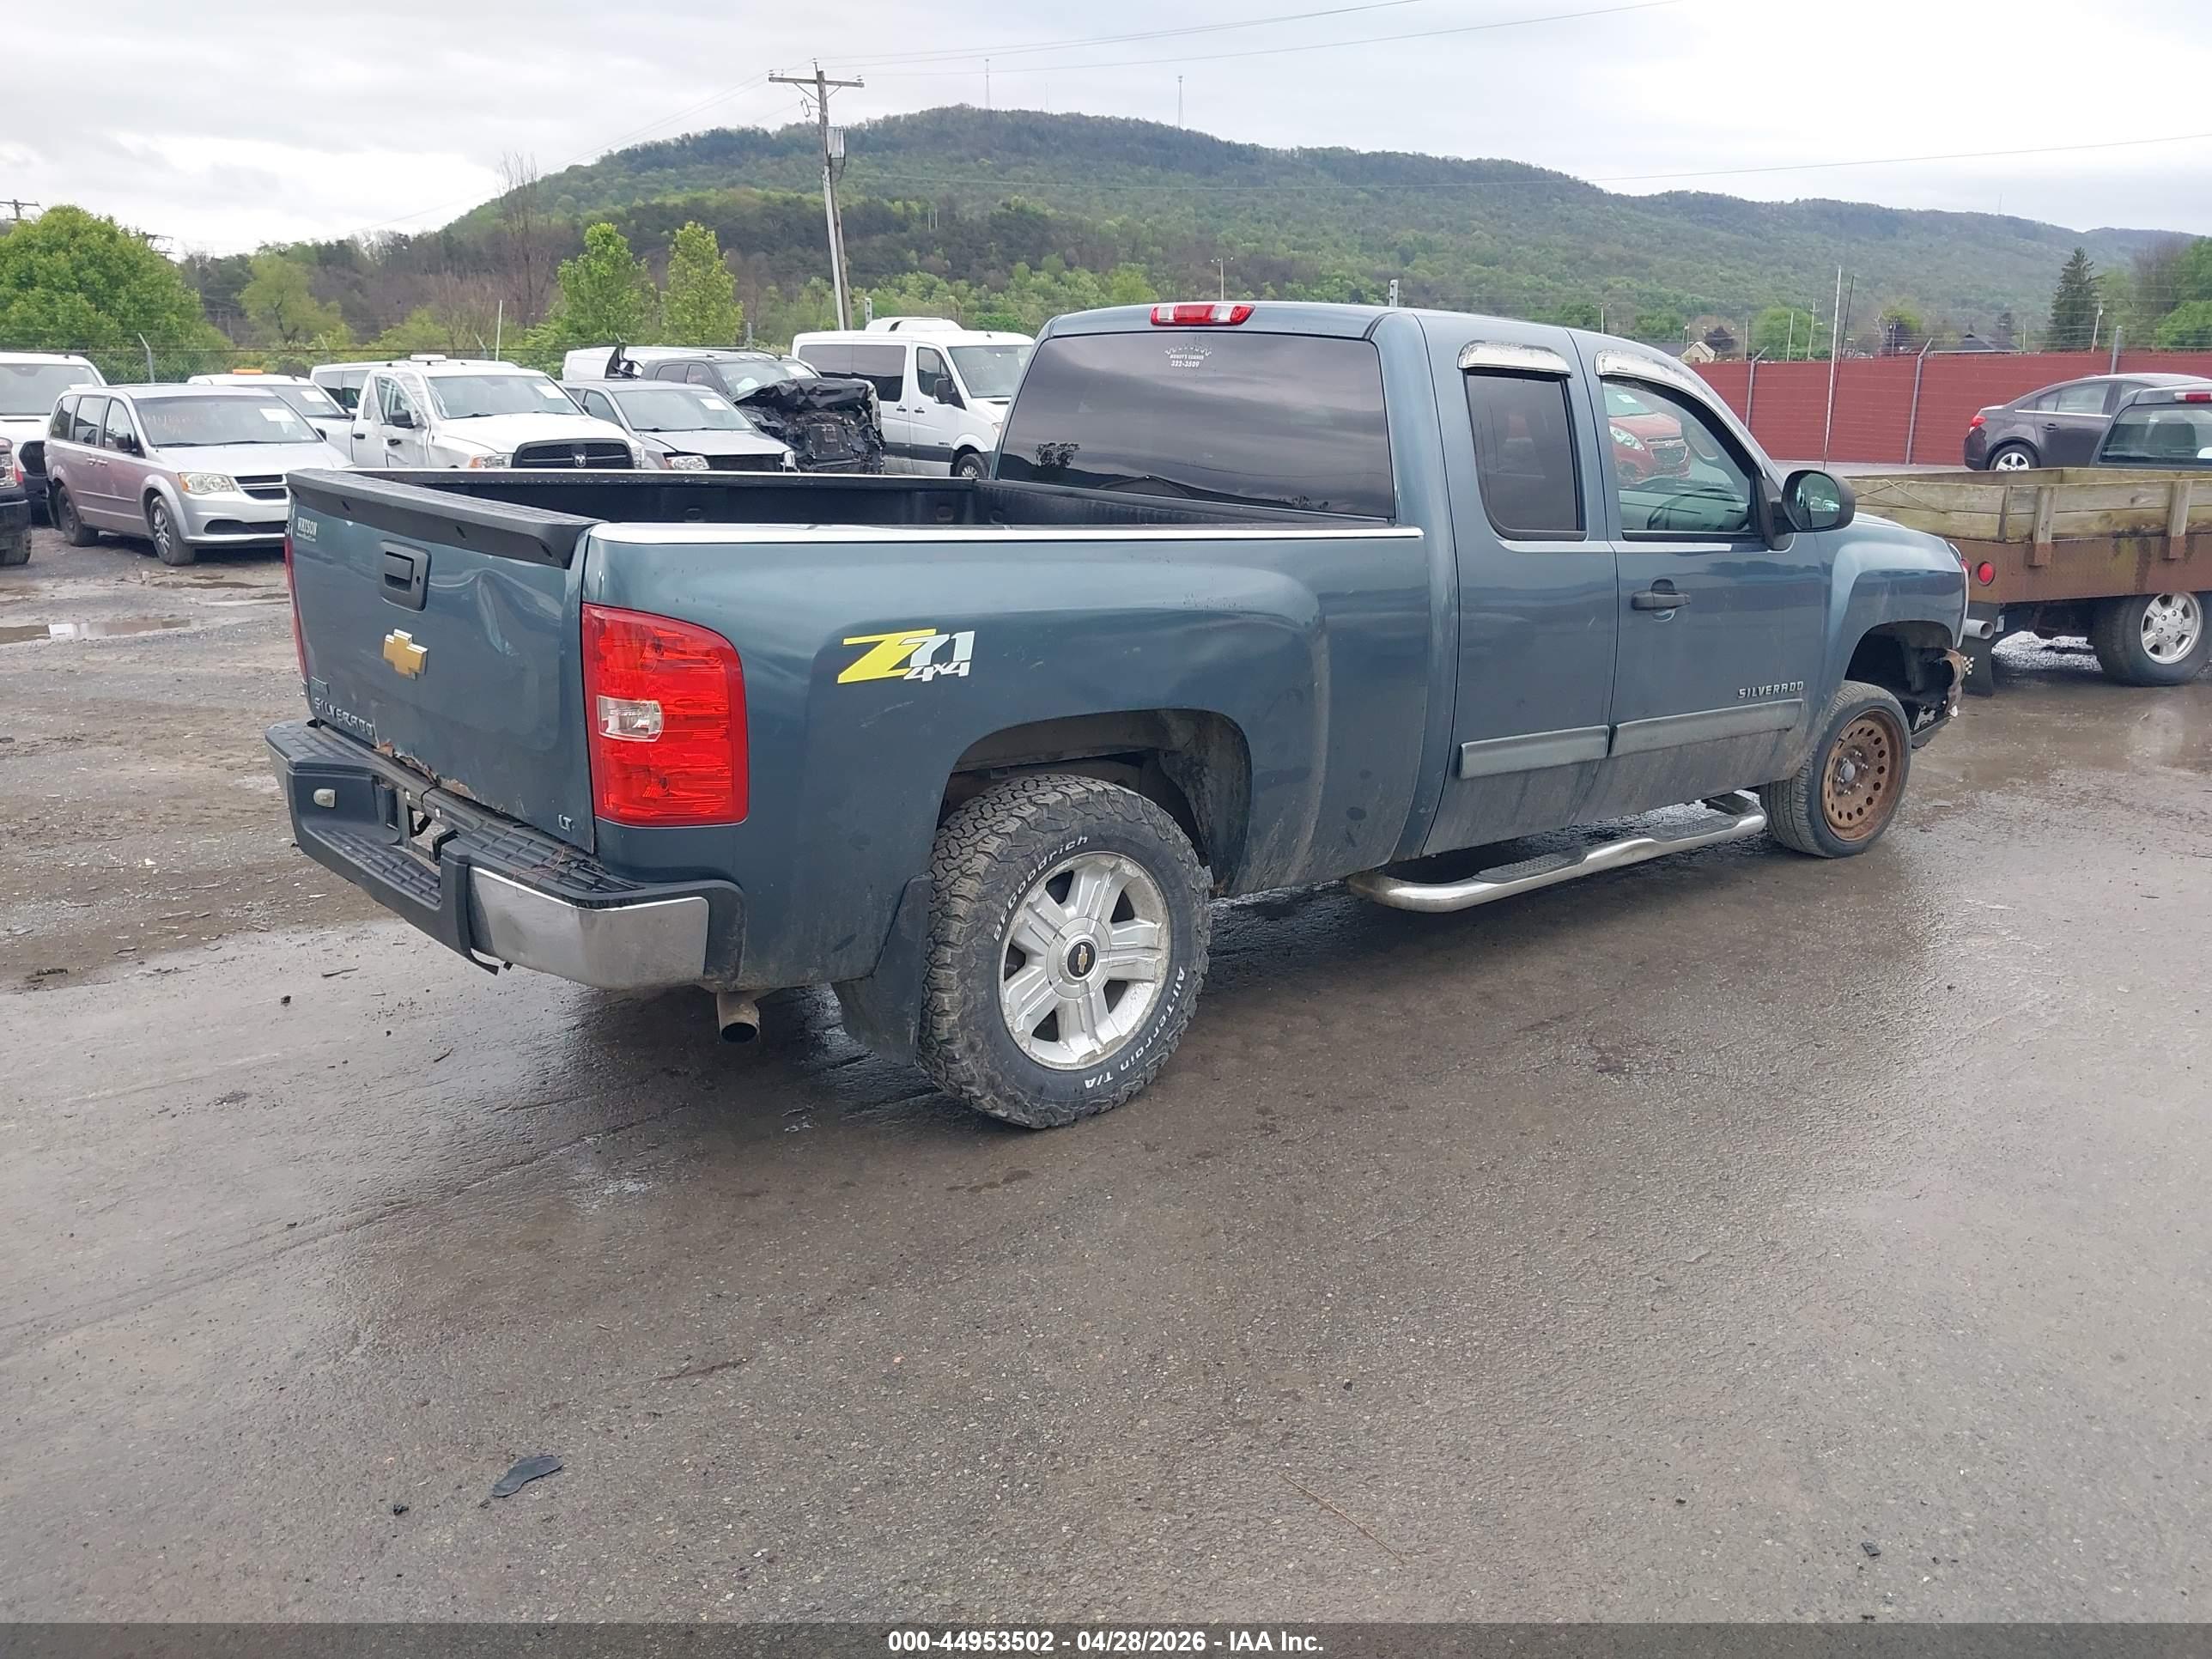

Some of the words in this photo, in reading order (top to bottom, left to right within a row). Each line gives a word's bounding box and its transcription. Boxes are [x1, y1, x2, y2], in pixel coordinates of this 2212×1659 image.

[297, 516, 318, 537] WATSON
[837, 628, 975, 684] Z71
[1738, 680, 1804, 699] SILVERADO
[314, 696, 374, 736] SILVERADO
[558, 814, 573, 833] LT
[993, 836, 1089, 942] BFGoodrich
[1119, 965, 1186, 1072] All-Terrain
[1084, 1071, 1114, 1090] T/A
